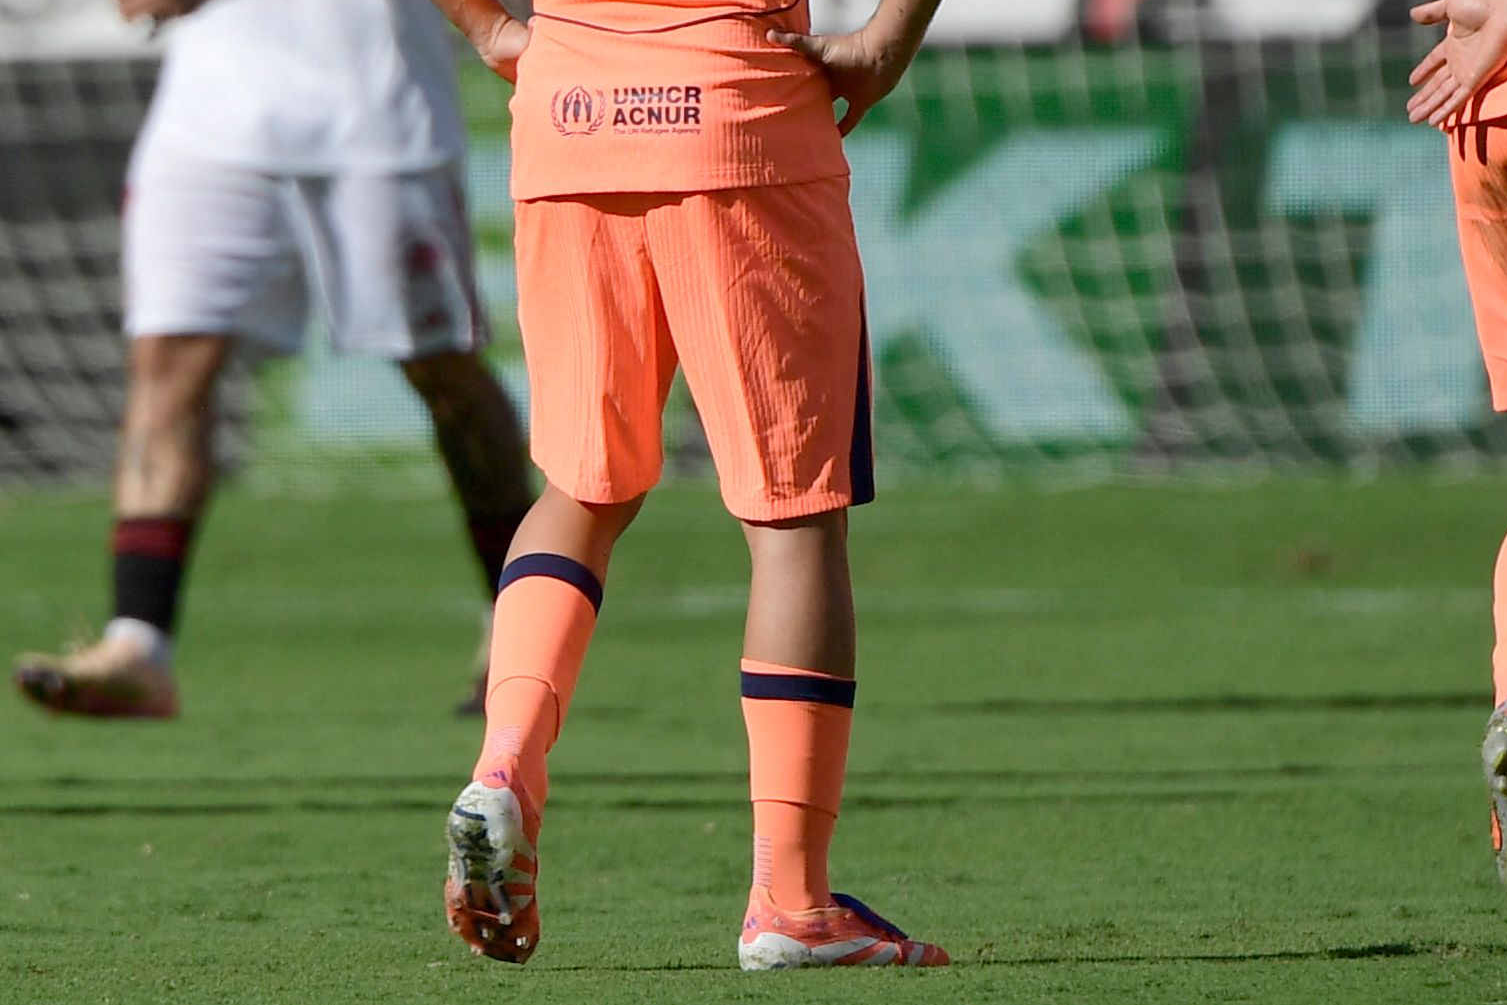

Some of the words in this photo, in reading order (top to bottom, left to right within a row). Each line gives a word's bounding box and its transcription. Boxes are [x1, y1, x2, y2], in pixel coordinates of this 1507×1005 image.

[613, 86, 702, 105] UNHCR
[612, 106, 701, 126] ACNUR
[672, 127, 701, 135] Agency
